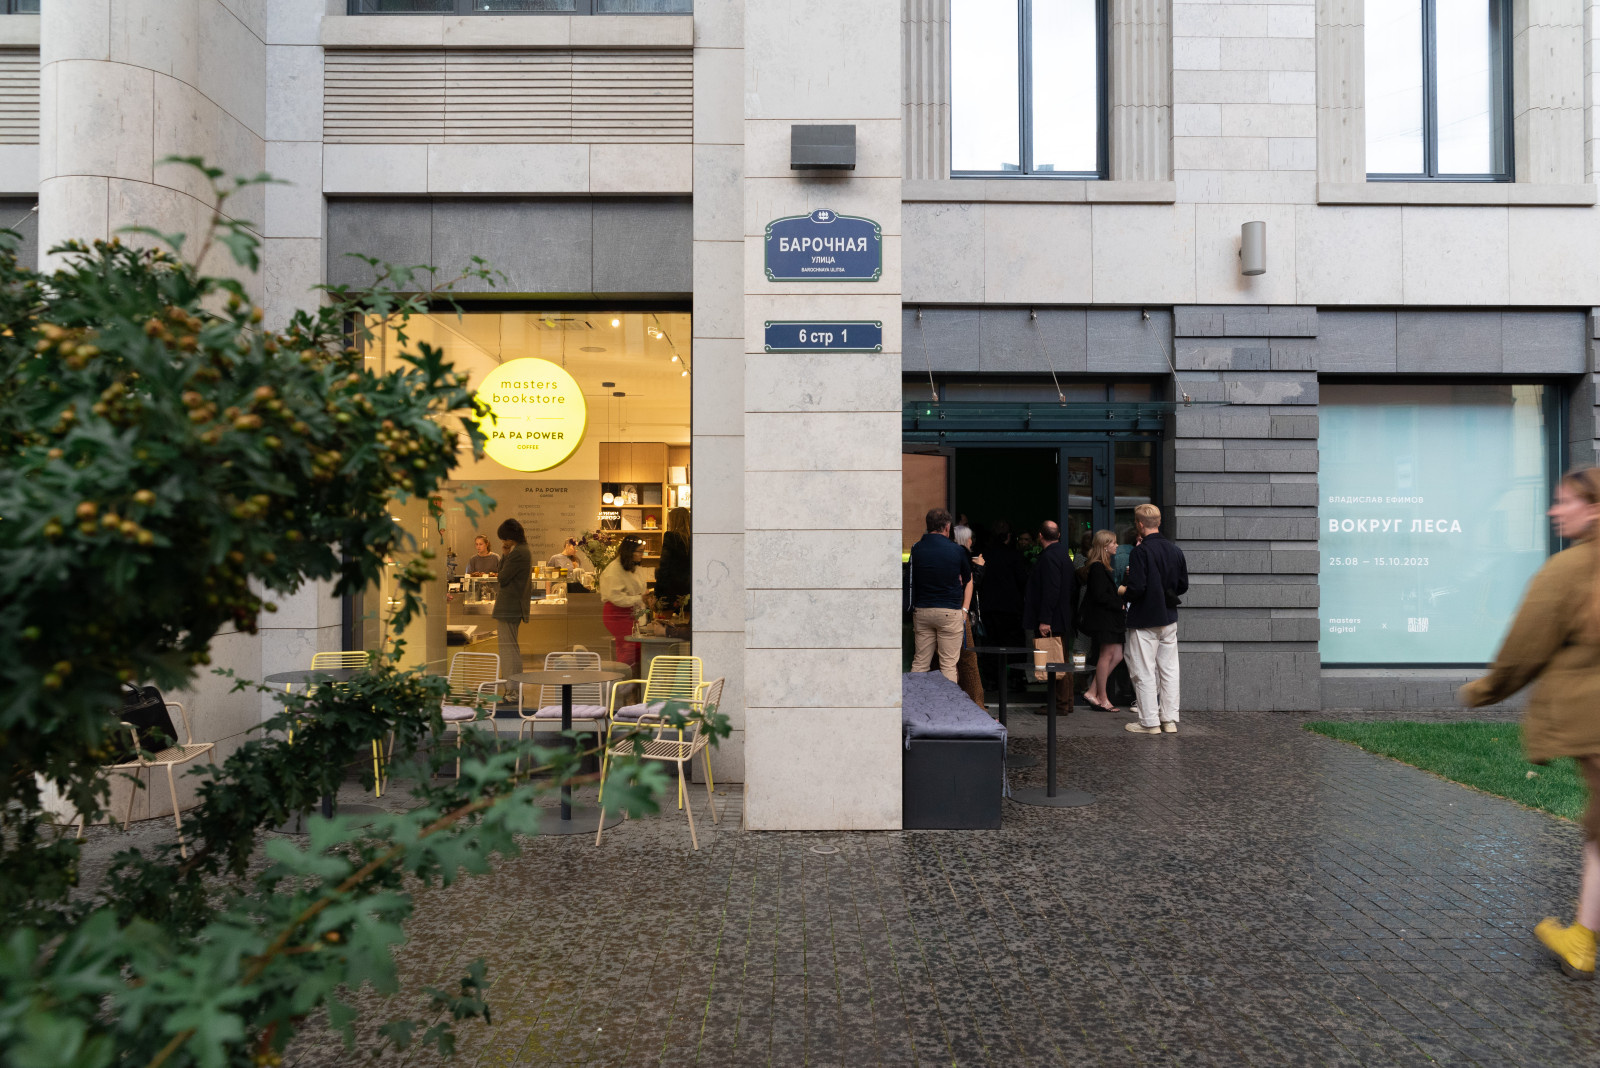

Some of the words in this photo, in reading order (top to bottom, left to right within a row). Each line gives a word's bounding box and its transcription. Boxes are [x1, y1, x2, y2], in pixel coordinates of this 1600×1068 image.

[779, 237, 867, 252] БАРОЧНАЯ
[811, 256, 836, 264] УЛИЦА
[799, 329, 807, 343] 6
[810, 332, 834, 346] стр
[841, 329, 847, 343] 1
[500, 380, 558, 389] masters
[492, 393, 565, 404] bookstore
[492, 431, 505, 439] PA
[509, 431, 523, 439] PA
[526, 431, 564, 440] POWER
[1328, 496, 1383, 504] ВЛАДИСЛАВ
[1385, 496, 1424, 504] ЕФИМОВ
[1328, 518, 1403, 533] ВОКРУГ
[1410, 519, 1462, 533] ЛЕСА
[1329, 557, 1359, 566] 25.08
[1374, 557, 1429, 566] 15.10.2023
[1329, 625, 1356, 634] digital
